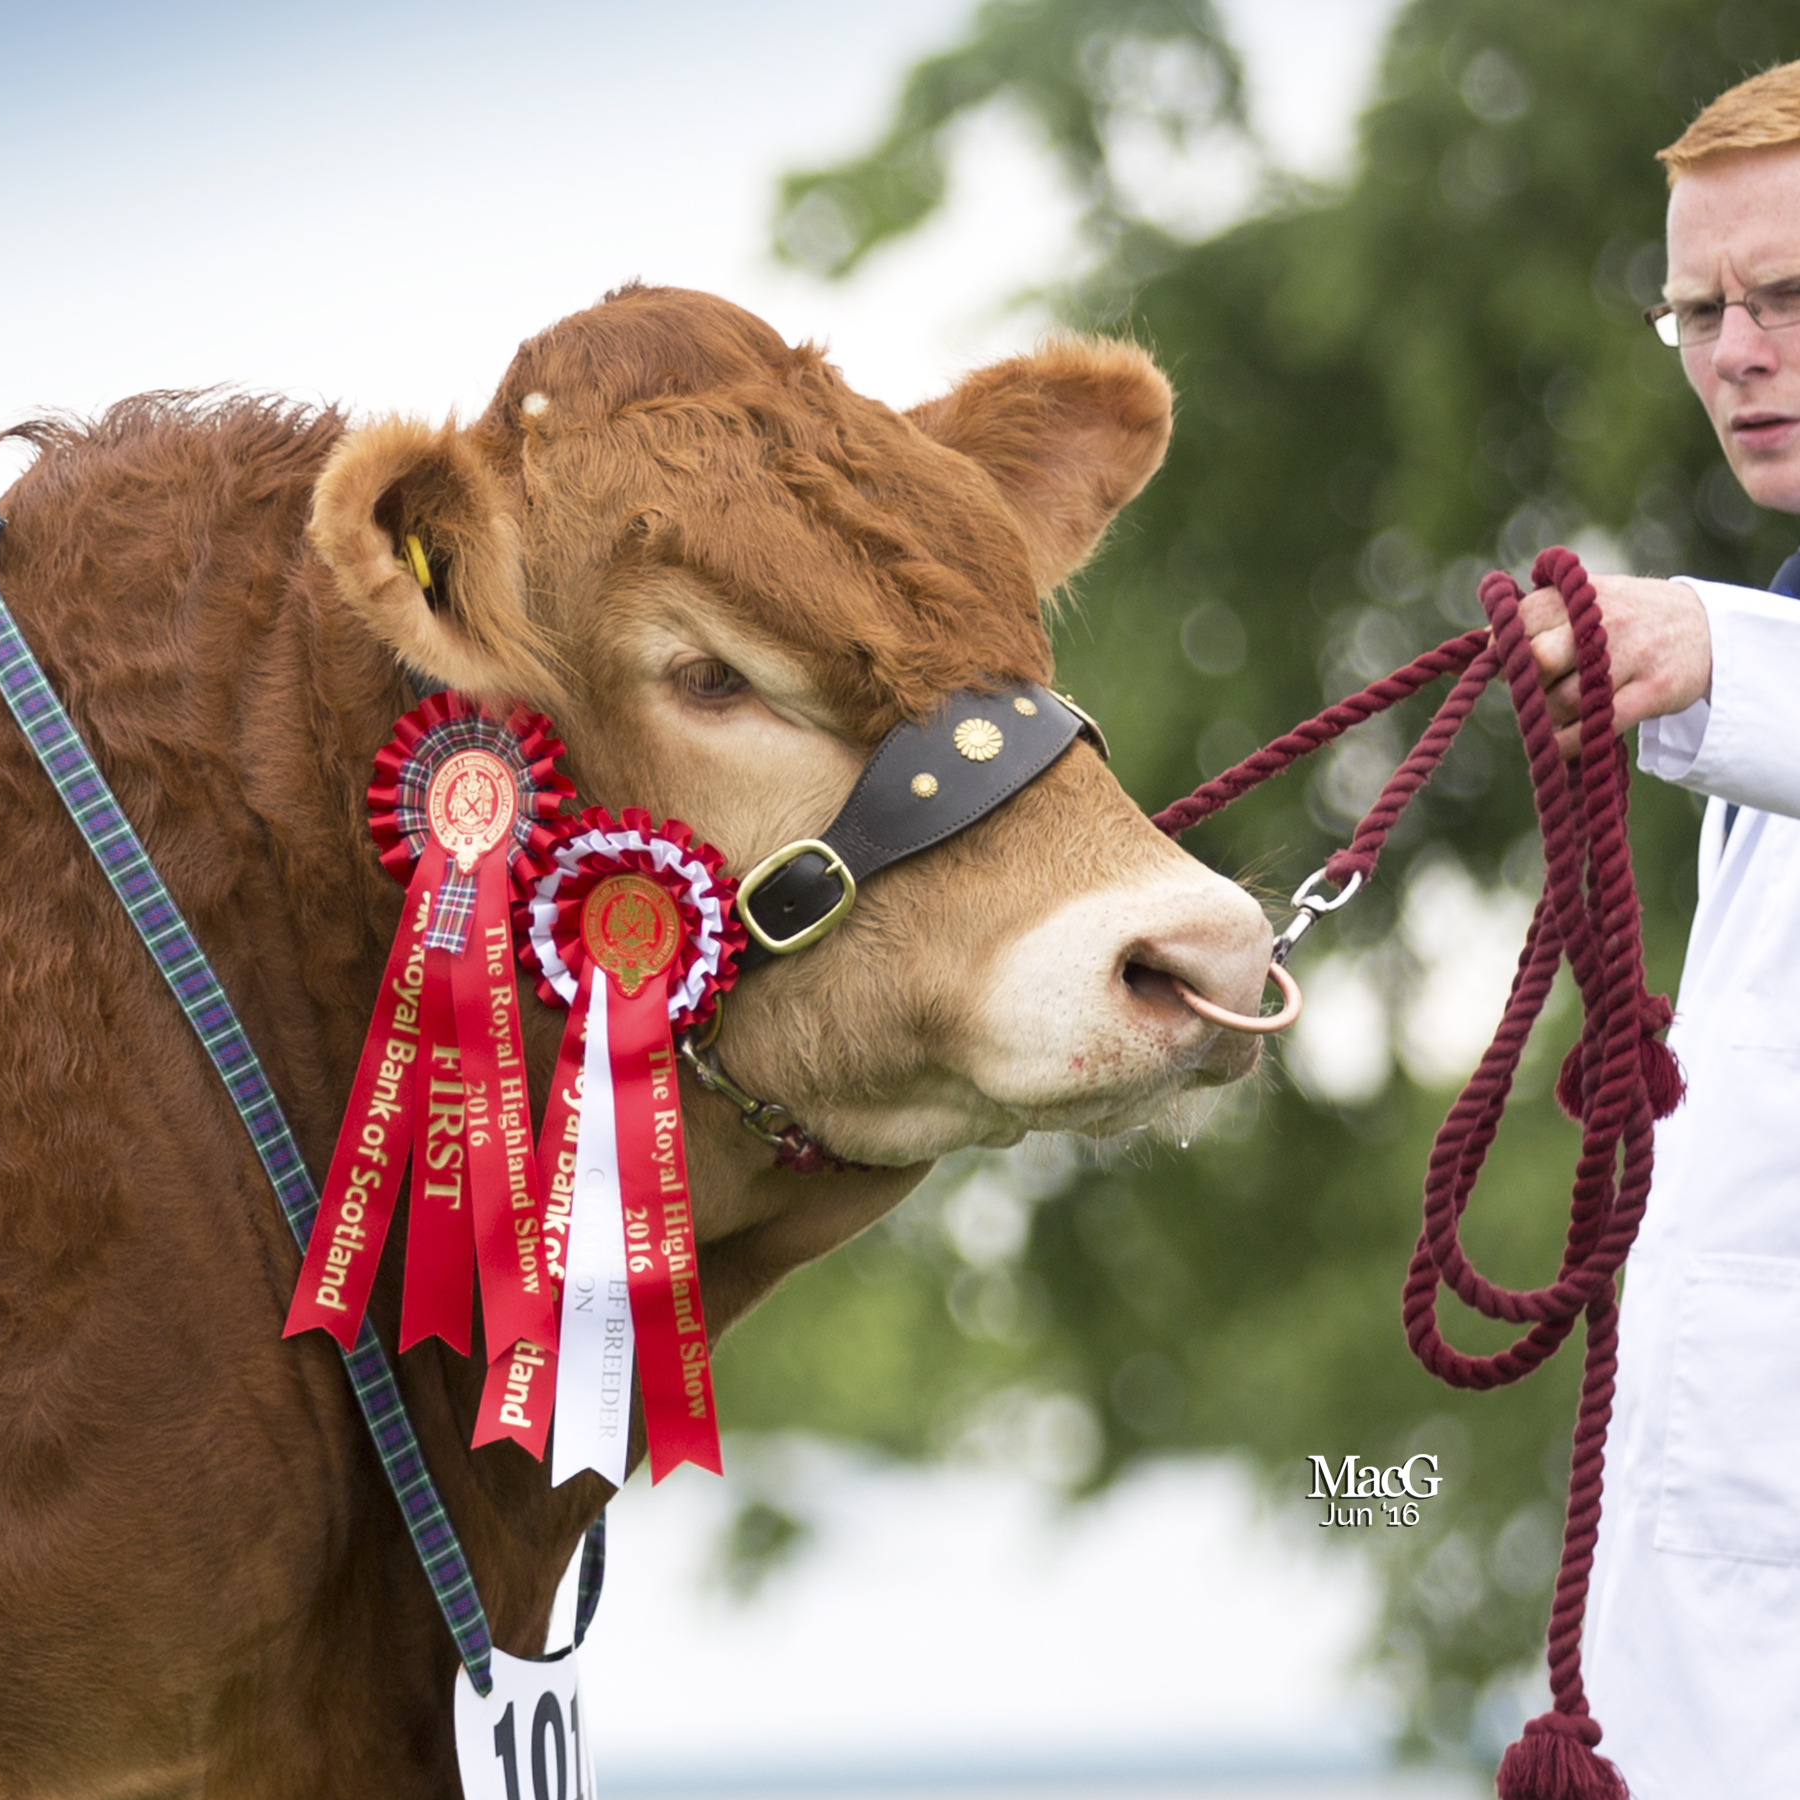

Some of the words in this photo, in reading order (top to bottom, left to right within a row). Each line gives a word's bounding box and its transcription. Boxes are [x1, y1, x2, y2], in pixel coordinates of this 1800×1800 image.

[485, 919, 508, 976] The
[488, 984, 520, 1069] Royal
[368, 1038, 418, 1122] Bank
[562, 1065, 584, 1143] oyal
[649, 1043, 673, 1101] The
[358, 1123, 388, 1167] of
[424, 1042, 466, 1210] FIRST
[465, 1081, 492, 1147] 2016
[498, 1077, 535, 1211] Highland
[651, 1108, 684, 1194] Royal
[315, 1166, 381, 1312] Scotland
[514, 1217, 541, 1296] Show
[625, 1206, 654, 1273] 2016
[661, 1201, 702, 1336] Highland
[599, 1318, 626, 1440] BREEDER
[679, 1341, 707, 1420] Show
